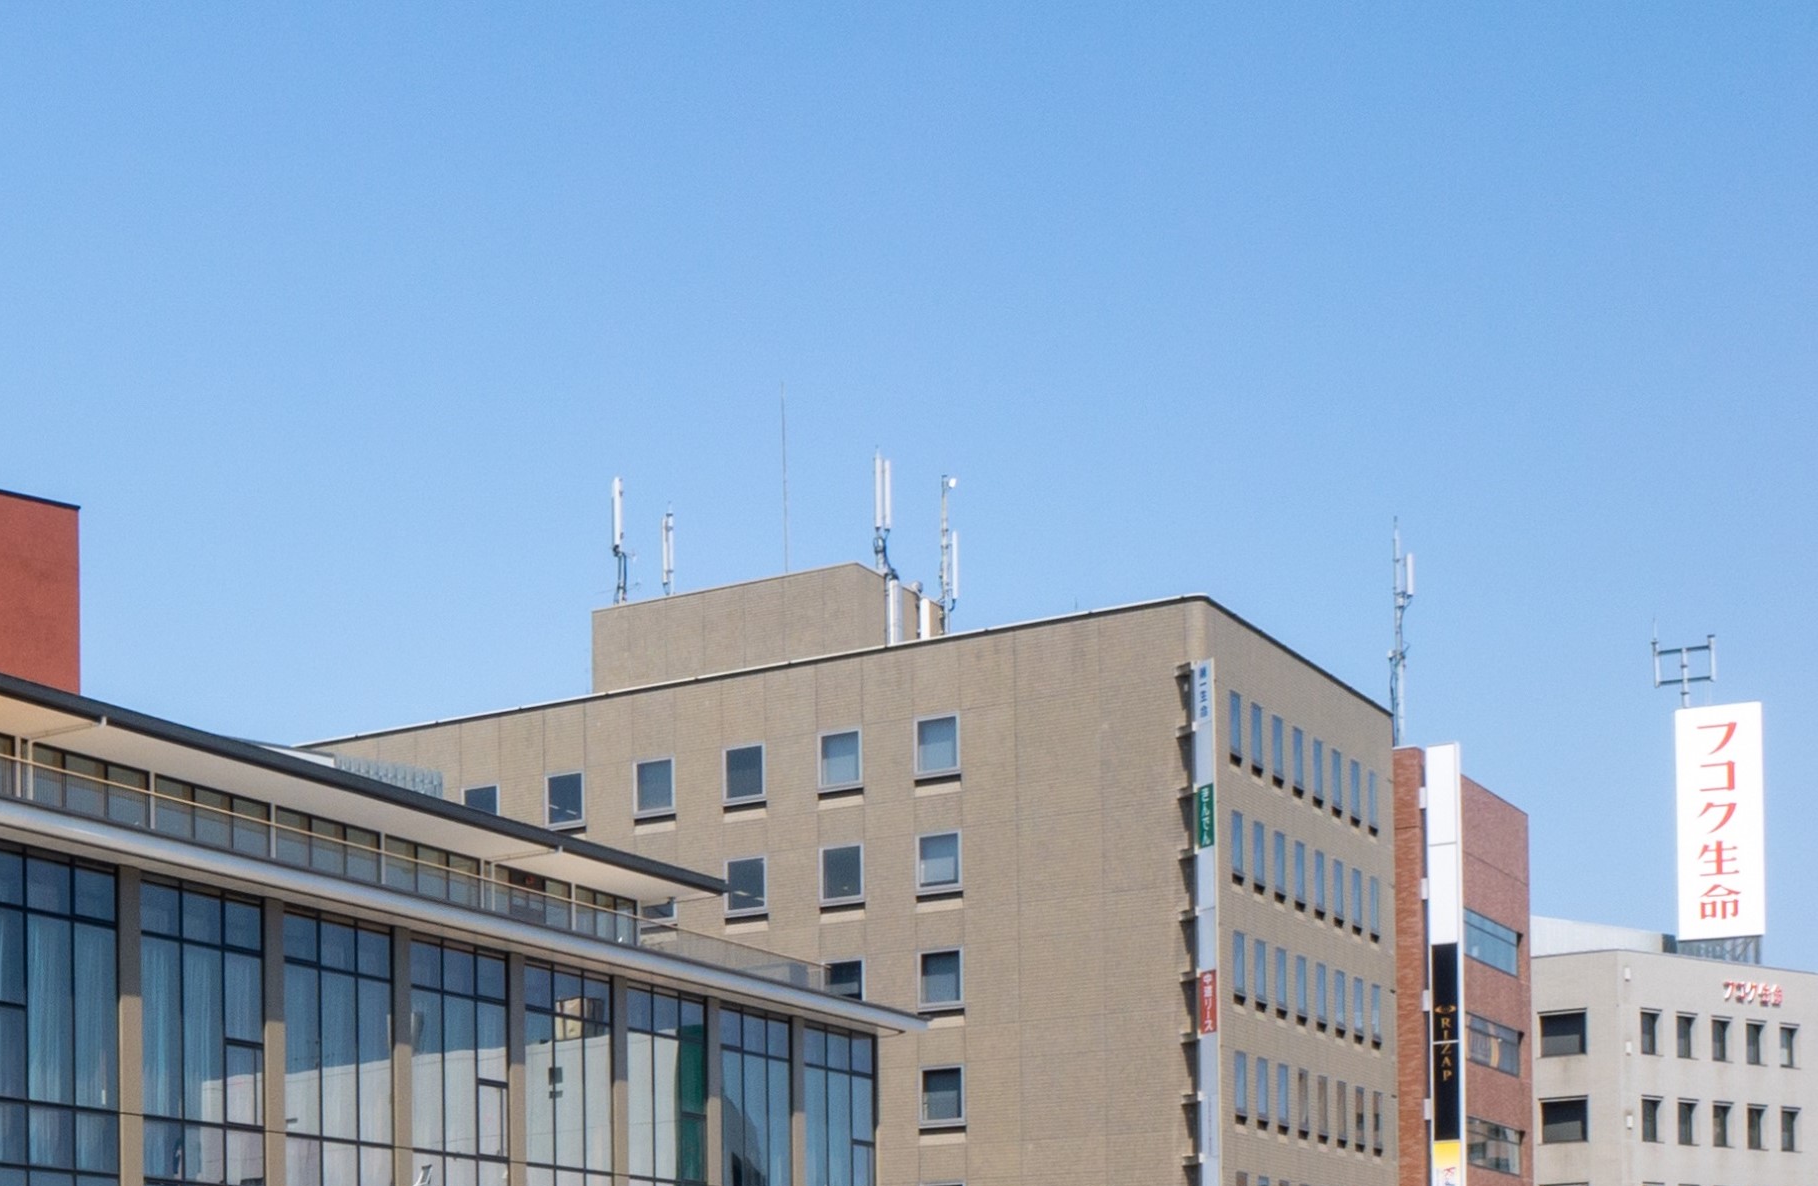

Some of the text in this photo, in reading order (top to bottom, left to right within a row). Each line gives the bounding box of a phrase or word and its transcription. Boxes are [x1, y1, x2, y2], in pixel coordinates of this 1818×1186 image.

[1201, 787, 1211, 846] きんでん
[1696, 721, 1741, 920] フコク生命
[1440, 1017, 1452, 1082] RIZAP
